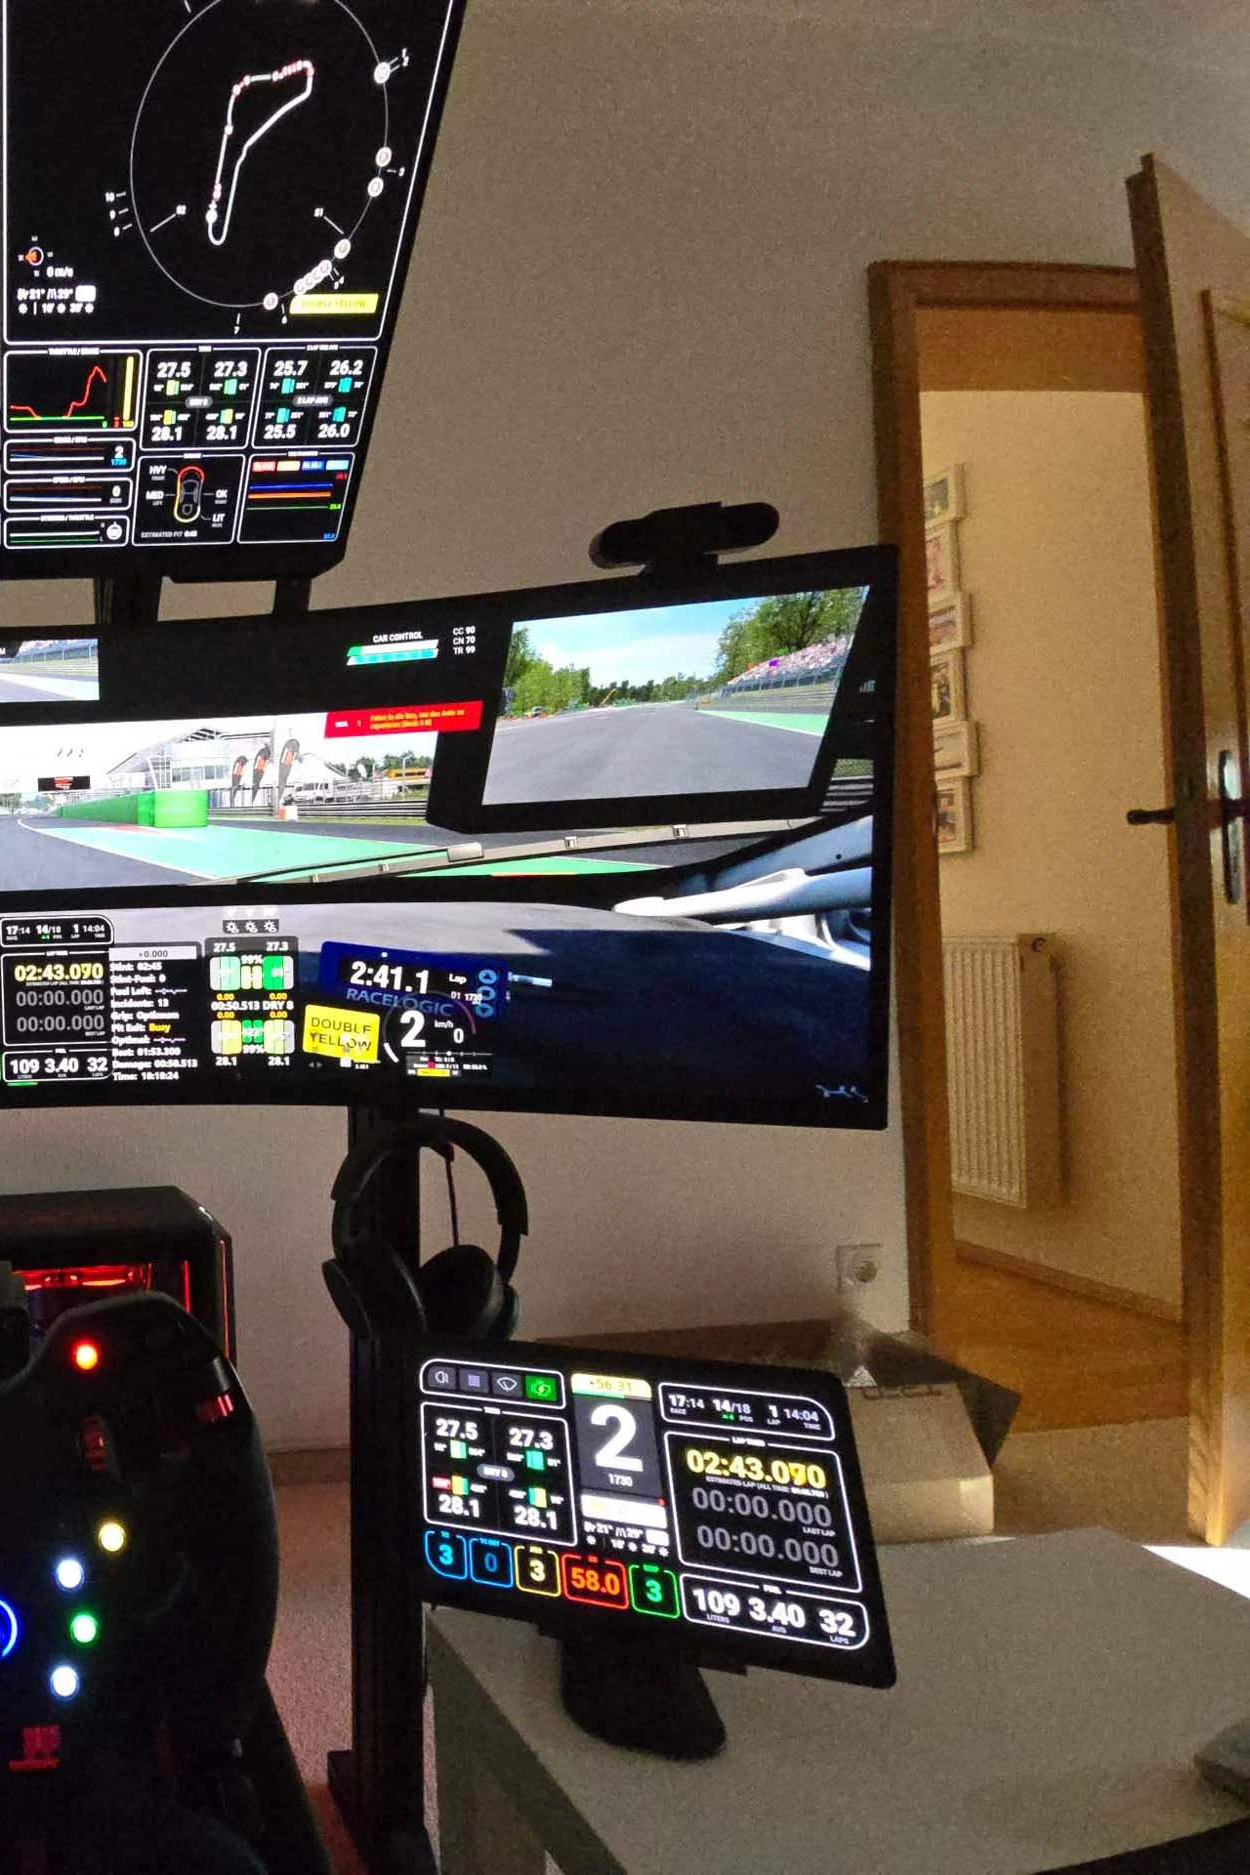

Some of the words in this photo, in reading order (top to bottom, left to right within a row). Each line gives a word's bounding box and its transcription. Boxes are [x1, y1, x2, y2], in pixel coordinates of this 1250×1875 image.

[157, 362, 191, 378] 27.5
[214, 361, 247, 377] 27.3
[273, 360, 308, 376] 25.7
[329, 360, 363, 375] 26.2
[151, 426, 182, 441] 28.1
[206, 425, 237, 440] 28.1
[264, 424, 297, 439] 25.5
[318, 424, 350, 438] 26.0
[115, 446, 124, 458] 2
[149, 465, 167, 474] HVY
[373, 635, 387, 643] CAR
[389, 632, 423, 641] CONTROL
[453, 627, 463, 635] CC
[466, 626, 475, 634] 90
[453, 637, 464, 645] CN
[466, 636, 475, 644] 70
[6, 925, 30, 935] 17:14
[36, 924, 61, 934] 14/18
[72, 924, 78, 933] 1
[83, 925, 104, 933] 14:04
[214, 943, 235, 952] 27.5
[266, 942, 289, 951] 27.3
[350, 961, 429, 994] 2:41.1
[449, 973, 467, 985] Lap
[16, 990, 103, 1006] 00:00.000
[262, 1001, 285, 1010] DRY
[347, 989, 454, 1016] RACELOGIC
[17, 1015, 104, 1032] 00:00.000
[149, 1023, 171, 1034] Busy
[311, 1018, 373, 1034] DOUBLE
[400, 1011, 426, 1047] 2
[435, 1020, 454, 1028] km/h
[454, 1028, 464, 1043] 0
[10, 1059, 40, 1074] 109
[44, 1058, 79, 1073] 3.40
[87, 1057, 108, 1072] 32
[668, 1395, 704, 1409] 17:14
[712, 1399, 750, 1414] 14/18
[768, 1405, 778, 1417] 1
[784, 1409, 819, 1422] 14:04
[436, 1418, 478, 1440] 27.5
[509, 1428, 553, 1450] 27.3
[591, 1404, 643, 1472] 2
[608, 1474, 633, 1487] 1730
[438, 1494, 480, 1518] 28.1
[514, 1505, 557, 1530] 28.1
[692, 1488, 831, 1527] 00:00.000
[698, 1525, 839, 1567] 00:00.000
[439, 1544, 453, 1565] 3
[485, 1553, 498, 1572] 0
[529, 1560, 545, 1581] 3
[571, 1567, 620, 1595] 58.0
[646, 1580, 662, 1602] 3
[693, 1588, 740, 1616] 109
[748, 1597, 805, 1628] 3.40
[819, 1609, 856, 1637] 32
